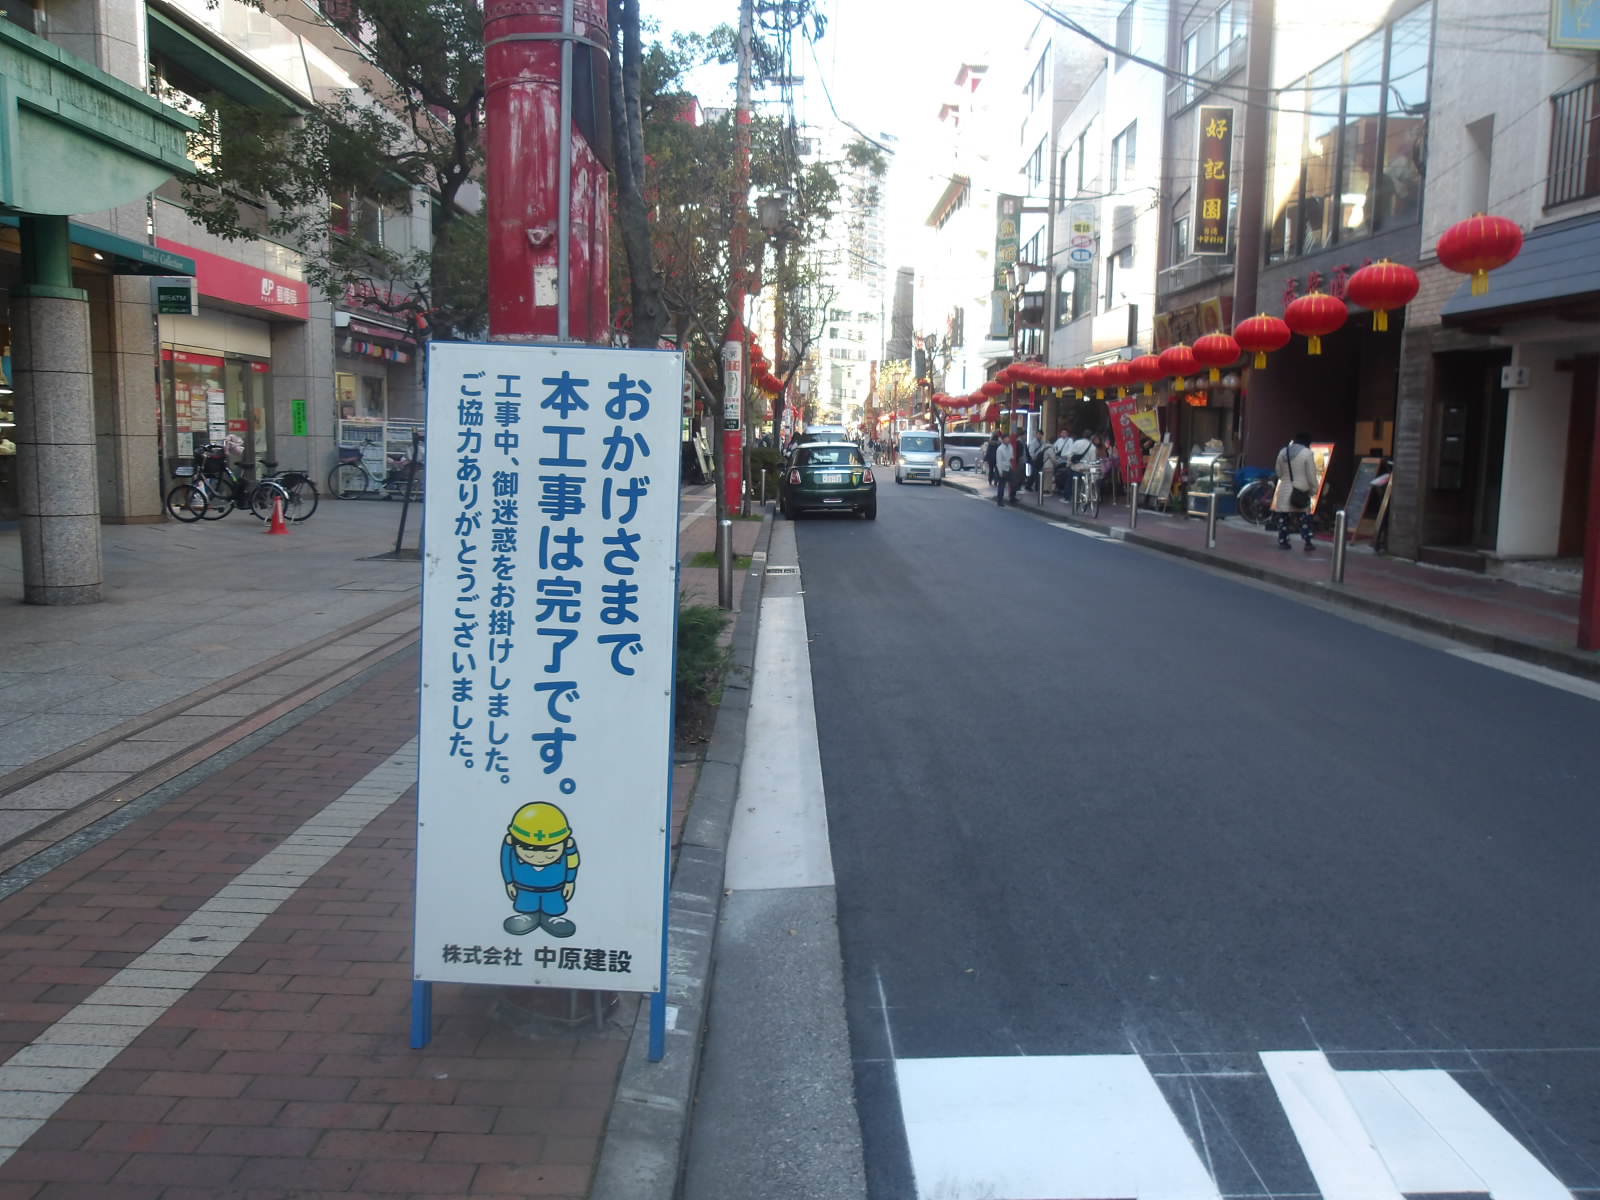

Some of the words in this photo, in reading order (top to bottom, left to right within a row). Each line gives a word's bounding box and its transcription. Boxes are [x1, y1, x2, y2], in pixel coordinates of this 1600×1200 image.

[1202, 118, 1228, 221] 好記園
[448, 372, 486, 770] ご協力ありがとうございました。
[484, 374, 522, 786] 工事中、御迷惑をお掛けしました。
[531, 370, 590, 795] 本工事は完了です。
[597, 372, 653, 677] おかげさまで
[442, 944, 523, 967] 株式会社
[534, 946, 632, 974] 中原建設
